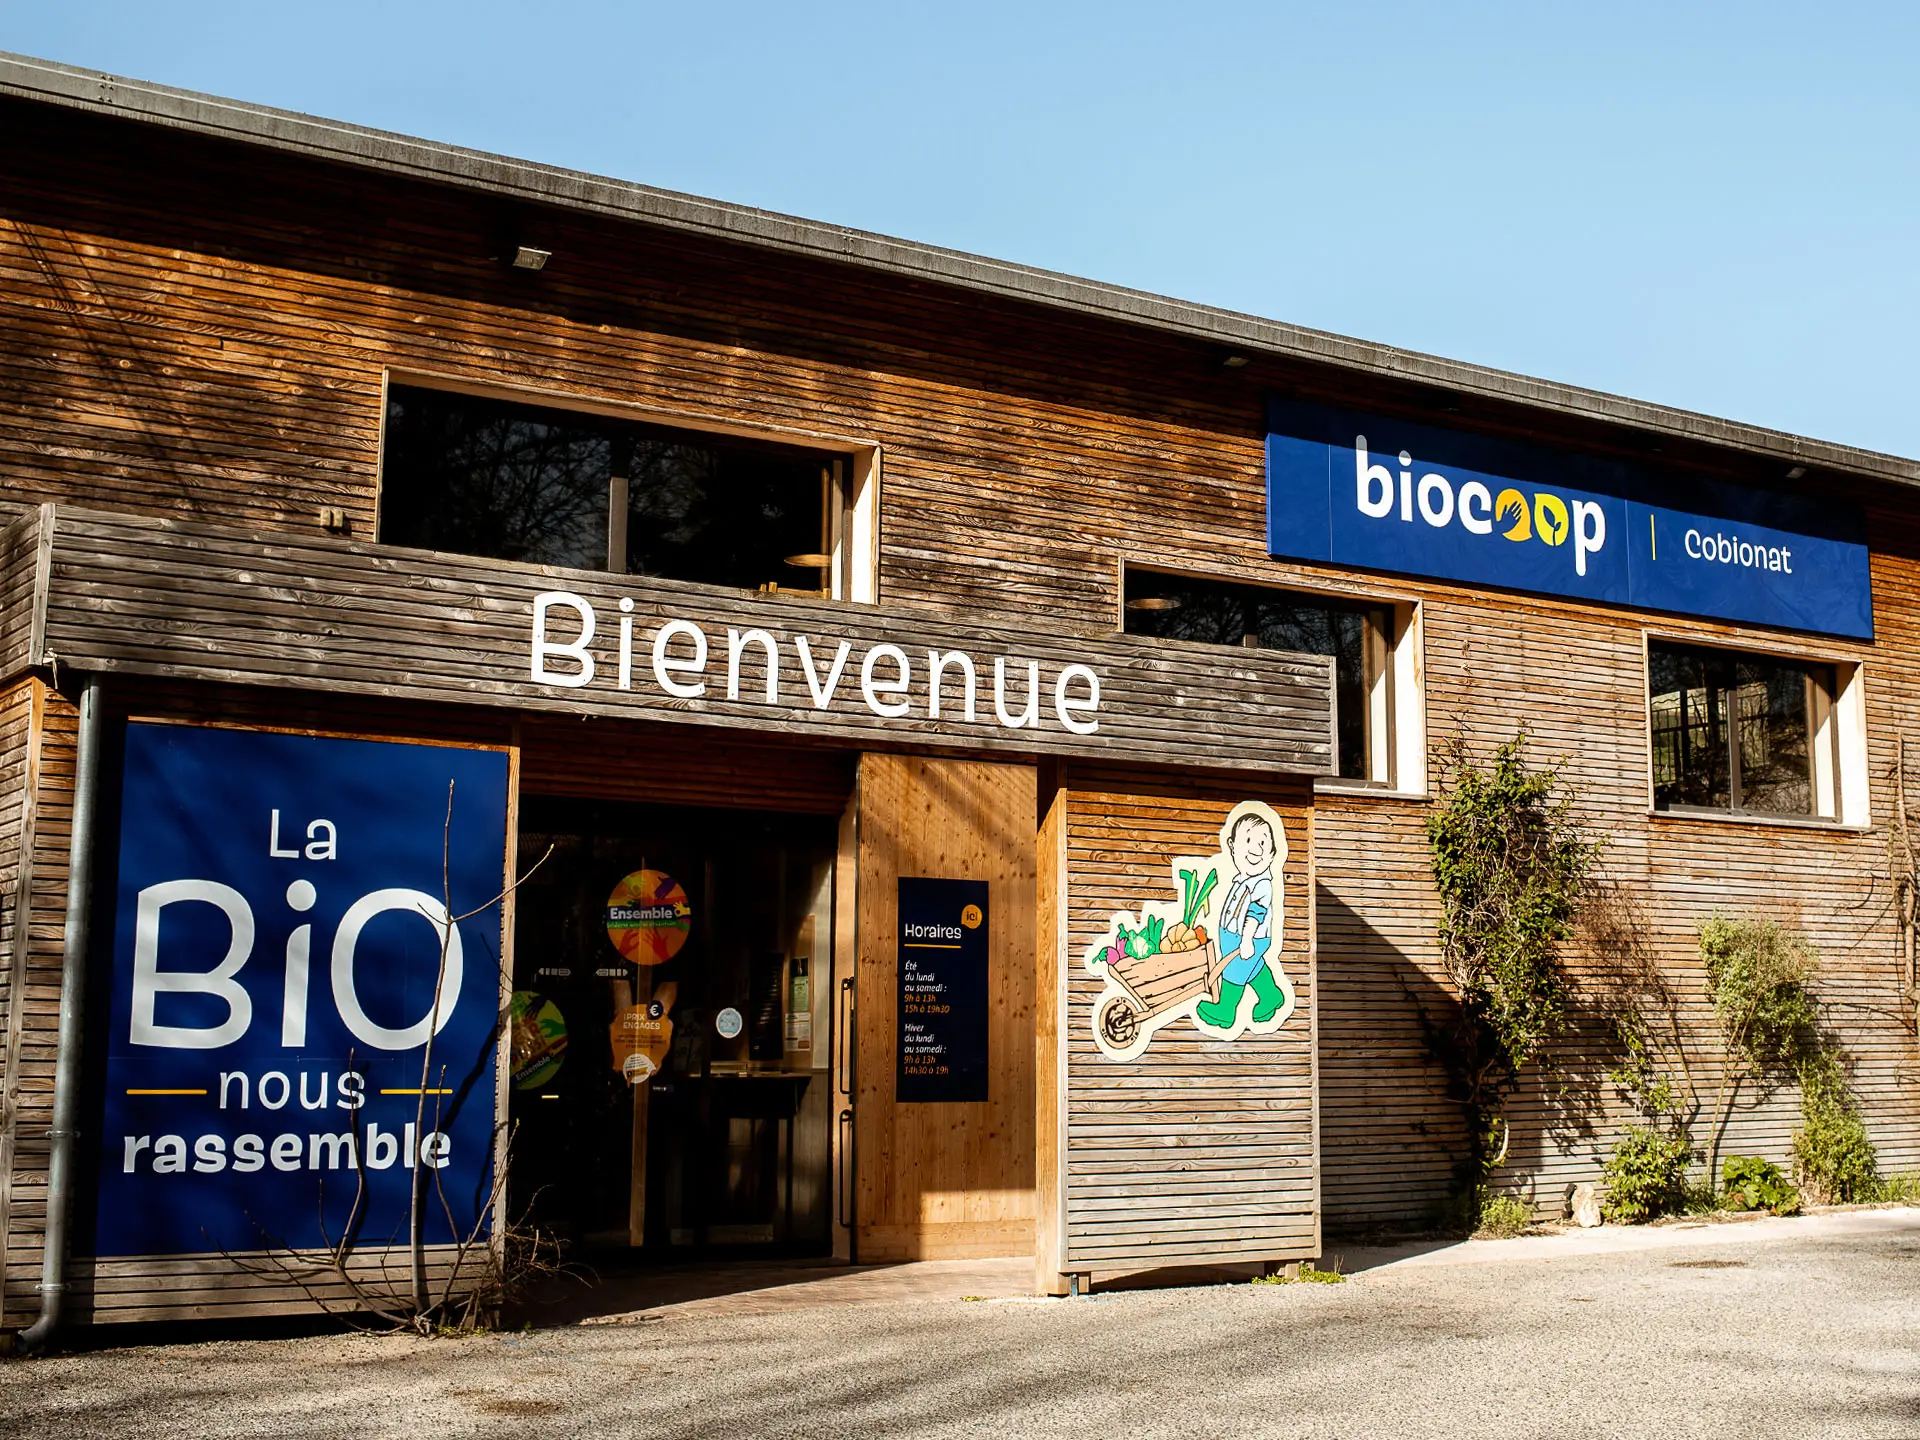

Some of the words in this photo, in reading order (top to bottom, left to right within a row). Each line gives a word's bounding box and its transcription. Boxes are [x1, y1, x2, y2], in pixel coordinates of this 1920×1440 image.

[1355, 434, 1606, 576] biocoop
[1684, 528, 1793, 574] Cobionat
[530, 590, 1101, 735] Bienvenue
[270, 809, 337, 860] La
[610, 906, 673, 920] Ensemble
[904, 923, 962, 939] Horaires
[904, 960, 918, 971] Été
[904, 972, 915, 982] du
[916, 972, 935, 982] lundi
[904, 984, 915, 992] au
[916, 983, 943, 992] samedi
[903, 994, 914, 1003] 9h
[922, 994, 937, 1003] 13h
[905, 1005, 919, 1014] 15h
[927, 1005, 951, 1014] 19h30
[904, 1023, 925, 1032] Hiver
[904, 1034, 915, 1043] du
[915, 1034, 936, 1043] lundi
[904, 1045, 915, 1054] au
[915, 1045, 943, 1054] samedi
[903, 1055, 914, 1064] 9h
[922, 1055, 936, 1064] 13h
[514, 1055, 551, 1081] Ensemble
[904, 1066, 928, 1075] 14h30
[935, 1066, 950, 1075] 19h
[219, 1071, 366, 1110] nous
[124, 1122, 451, 1173] rassemble
